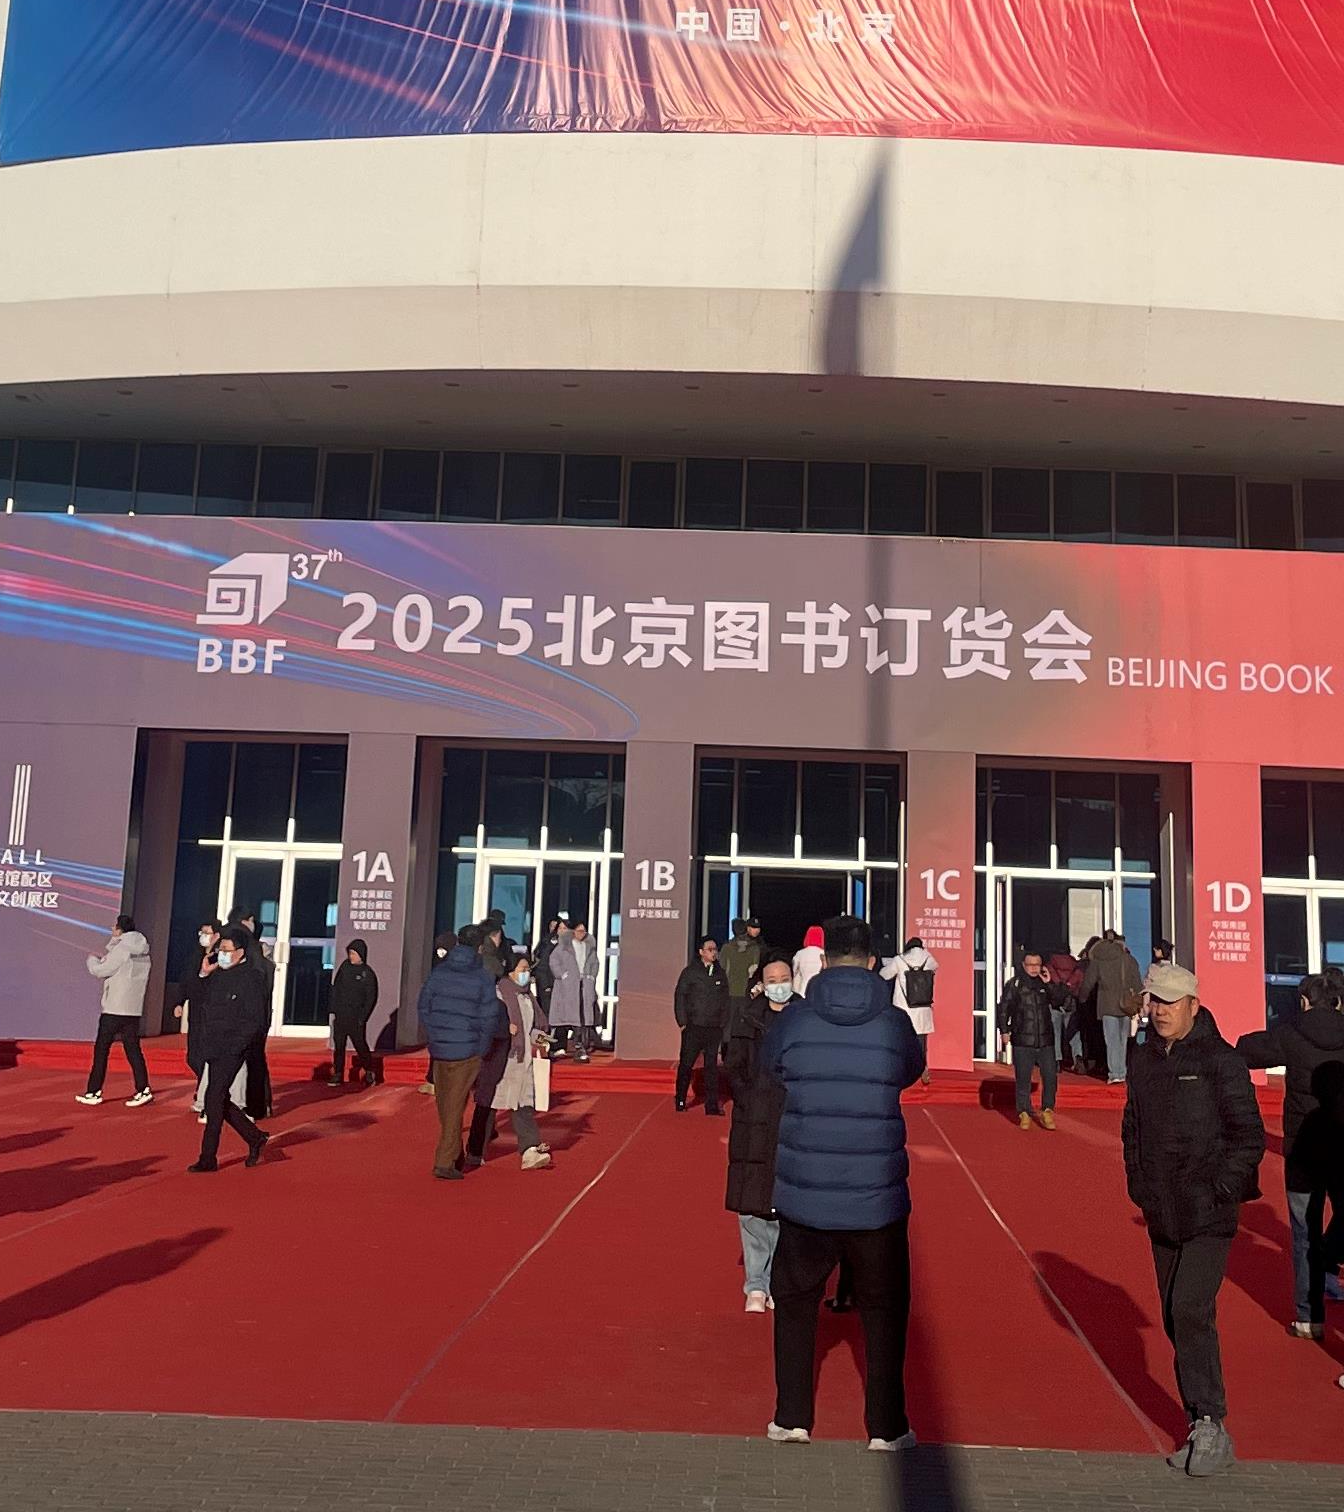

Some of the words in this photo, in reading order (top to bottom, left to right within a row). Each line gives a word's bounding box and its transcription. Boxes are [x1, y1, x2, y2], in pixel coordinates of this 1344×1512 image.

[291, 548, 343, 580] 37th
[336, 592, 1093, 684] 2025北京图书订货会
[197, 638, 287, 674] BBF
[1106, 657, 1227, 691] BEIJING
[1240, 662, 1333, 695] BOOK
[352, 850, 395, 882] 1A
[635, 859, 676, 891] 1B
[920, 868, 960, 901] 1C
[1206, 880, 1252, 913] 1D
